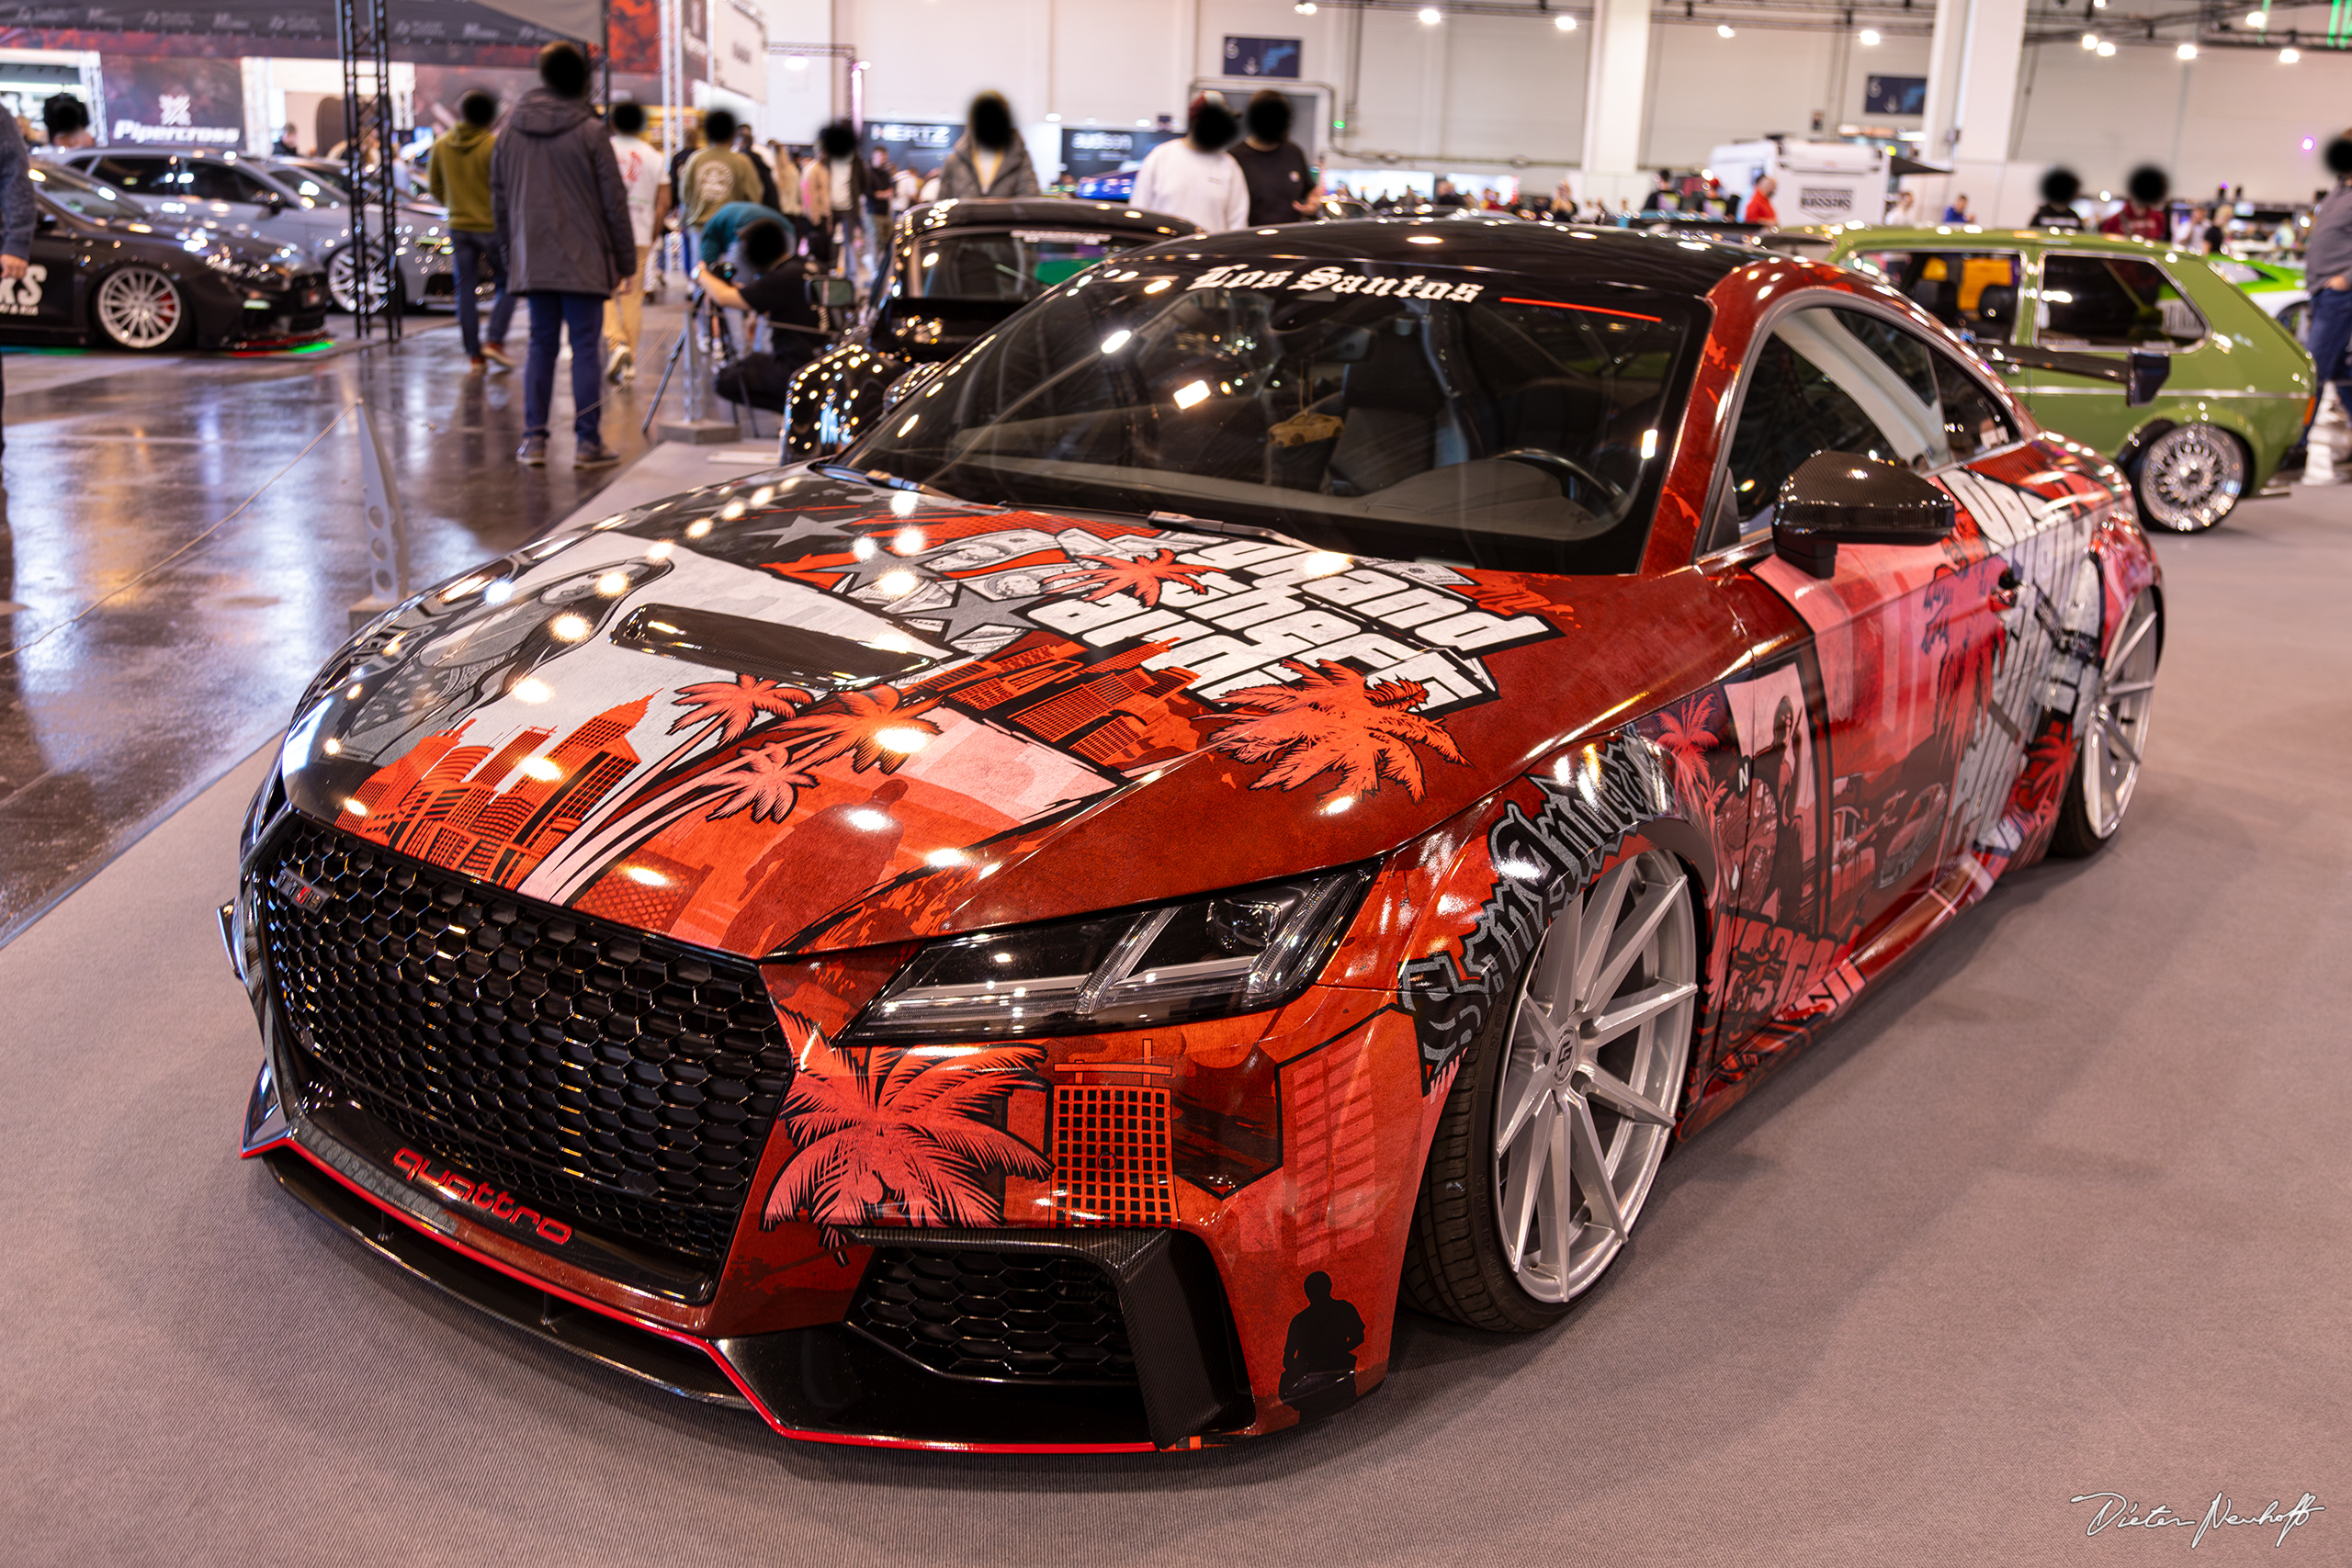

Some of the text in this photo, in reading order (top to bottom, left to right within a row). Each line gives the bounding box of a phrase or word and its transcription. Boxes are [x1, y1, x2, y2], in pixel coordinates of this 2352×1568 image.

[113, 119, 241, 144] Pipercross
[1186, 264, 1485, 303] Los Santos
[391, 1146, 573, 1246] quattro
